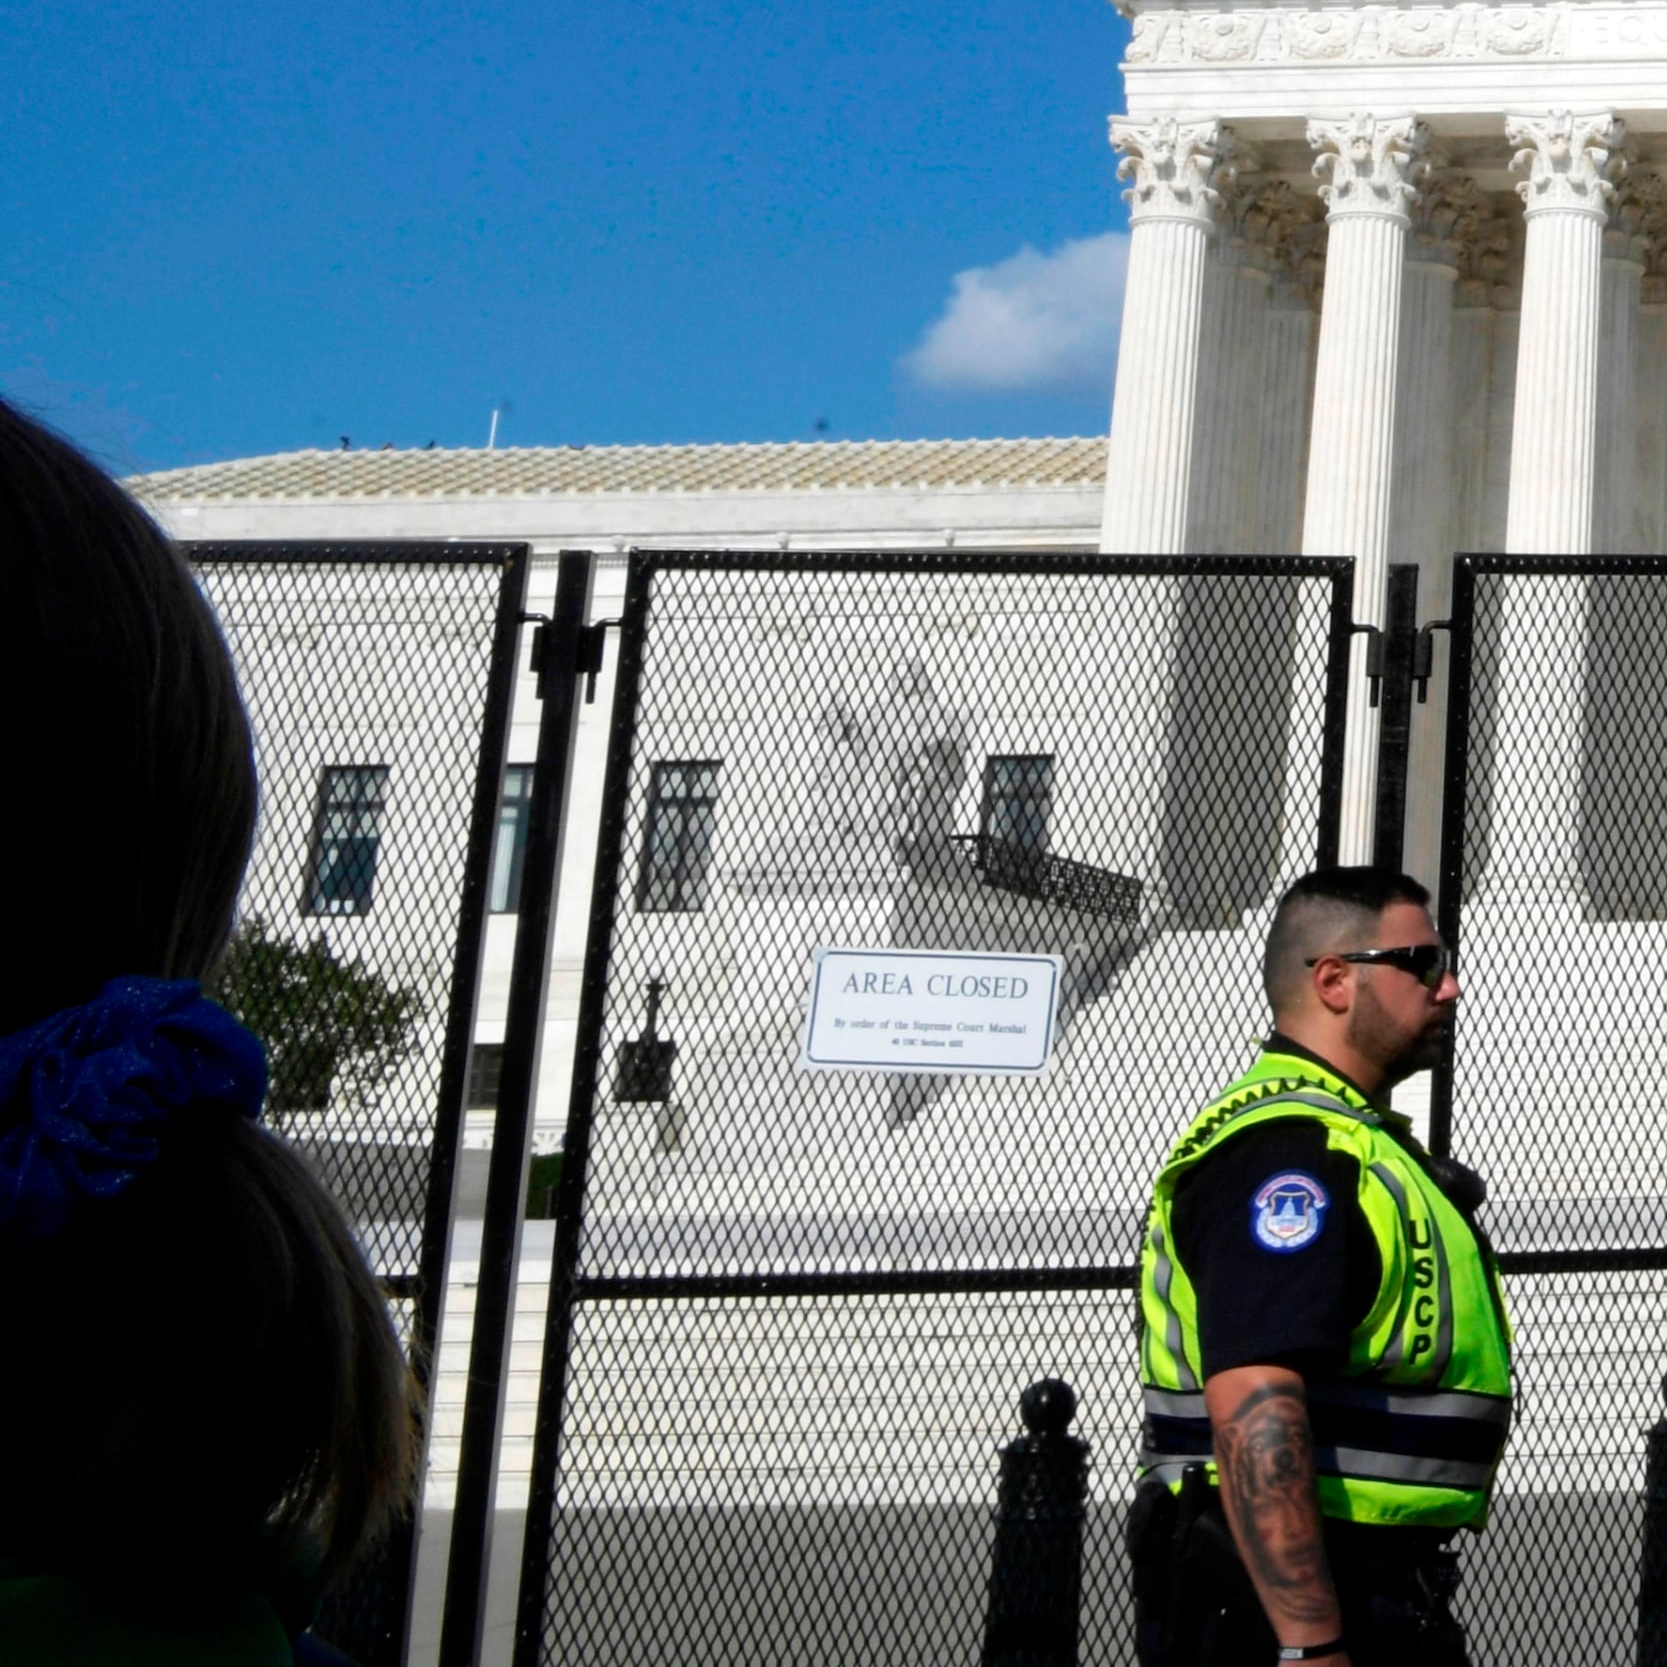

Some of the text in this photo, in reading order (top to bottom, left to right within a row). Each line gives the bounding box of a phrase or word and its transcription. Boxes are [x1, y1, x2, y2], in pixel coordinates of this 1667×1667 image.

[842, 972, 1029, 999] AREA CLOSED
[834, 1018, 1027, 1034] By order of the Supreme Court Marshal
[1409, 1218, 1434, 1366] USCP
